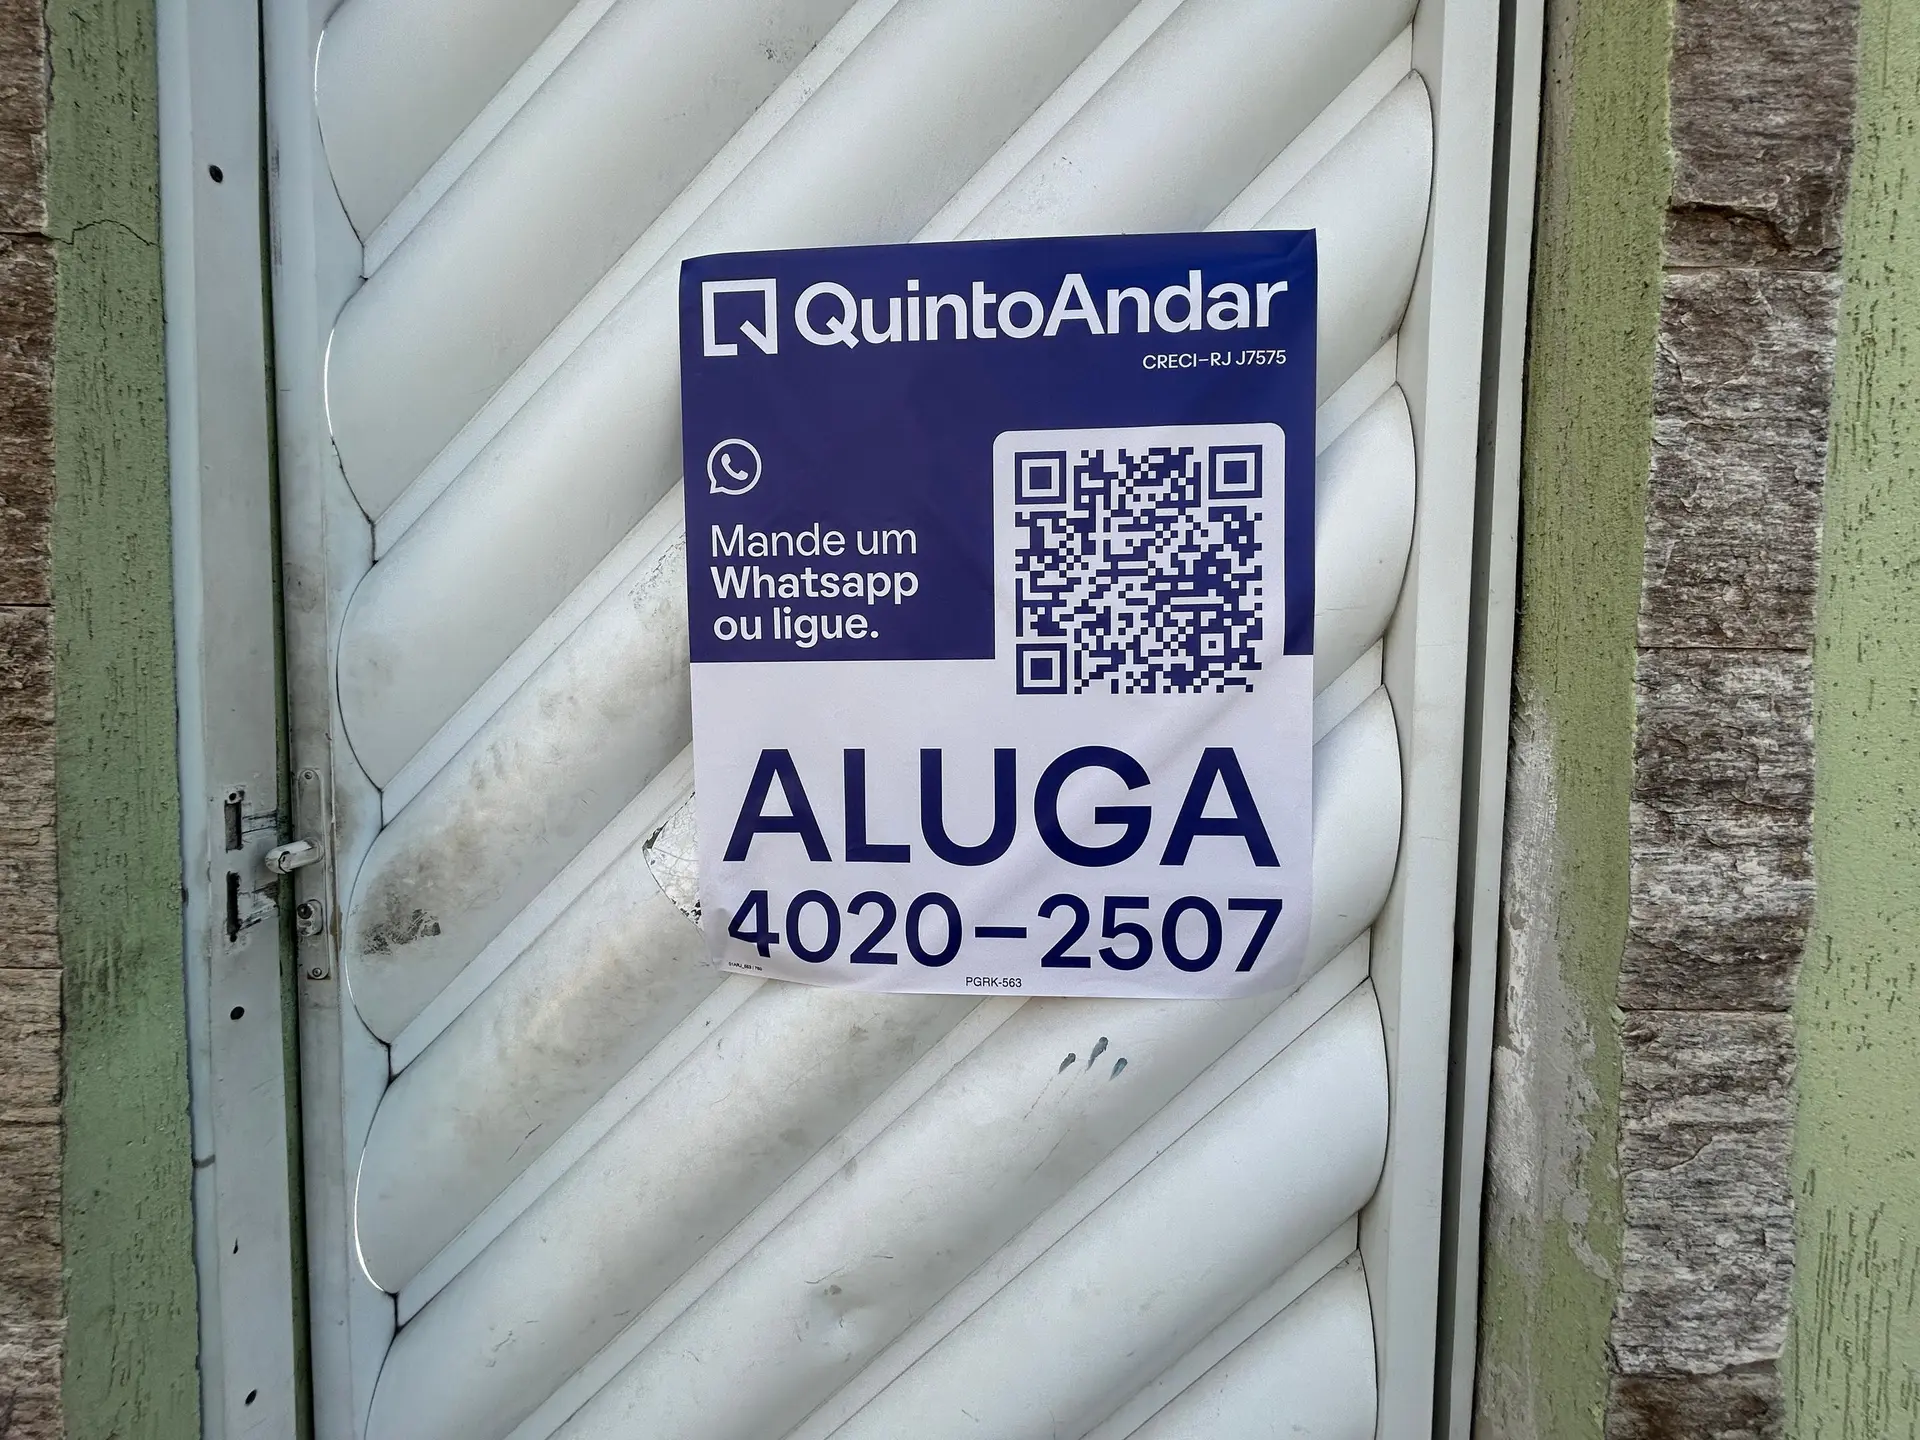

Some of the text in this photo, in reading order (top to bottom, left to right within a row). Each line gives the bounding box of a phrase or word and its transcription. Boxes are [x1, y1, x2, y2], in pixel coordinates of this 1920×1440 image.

[794, 269, 1288, 350] QuintoAndar
[1142, 349, 1287, 370] CRECI-RJ J7575
[711, 522, 917, 558] Mande um
[710, 565, 919, 606] Whatsapp
[713, 606, 879, 649] ou ligue.
[722, 745, 1281, 868] ALUGA
[727, 889, 1283, 973] 4020-2507
[965, 976, 1022, 988] PGRK-563
